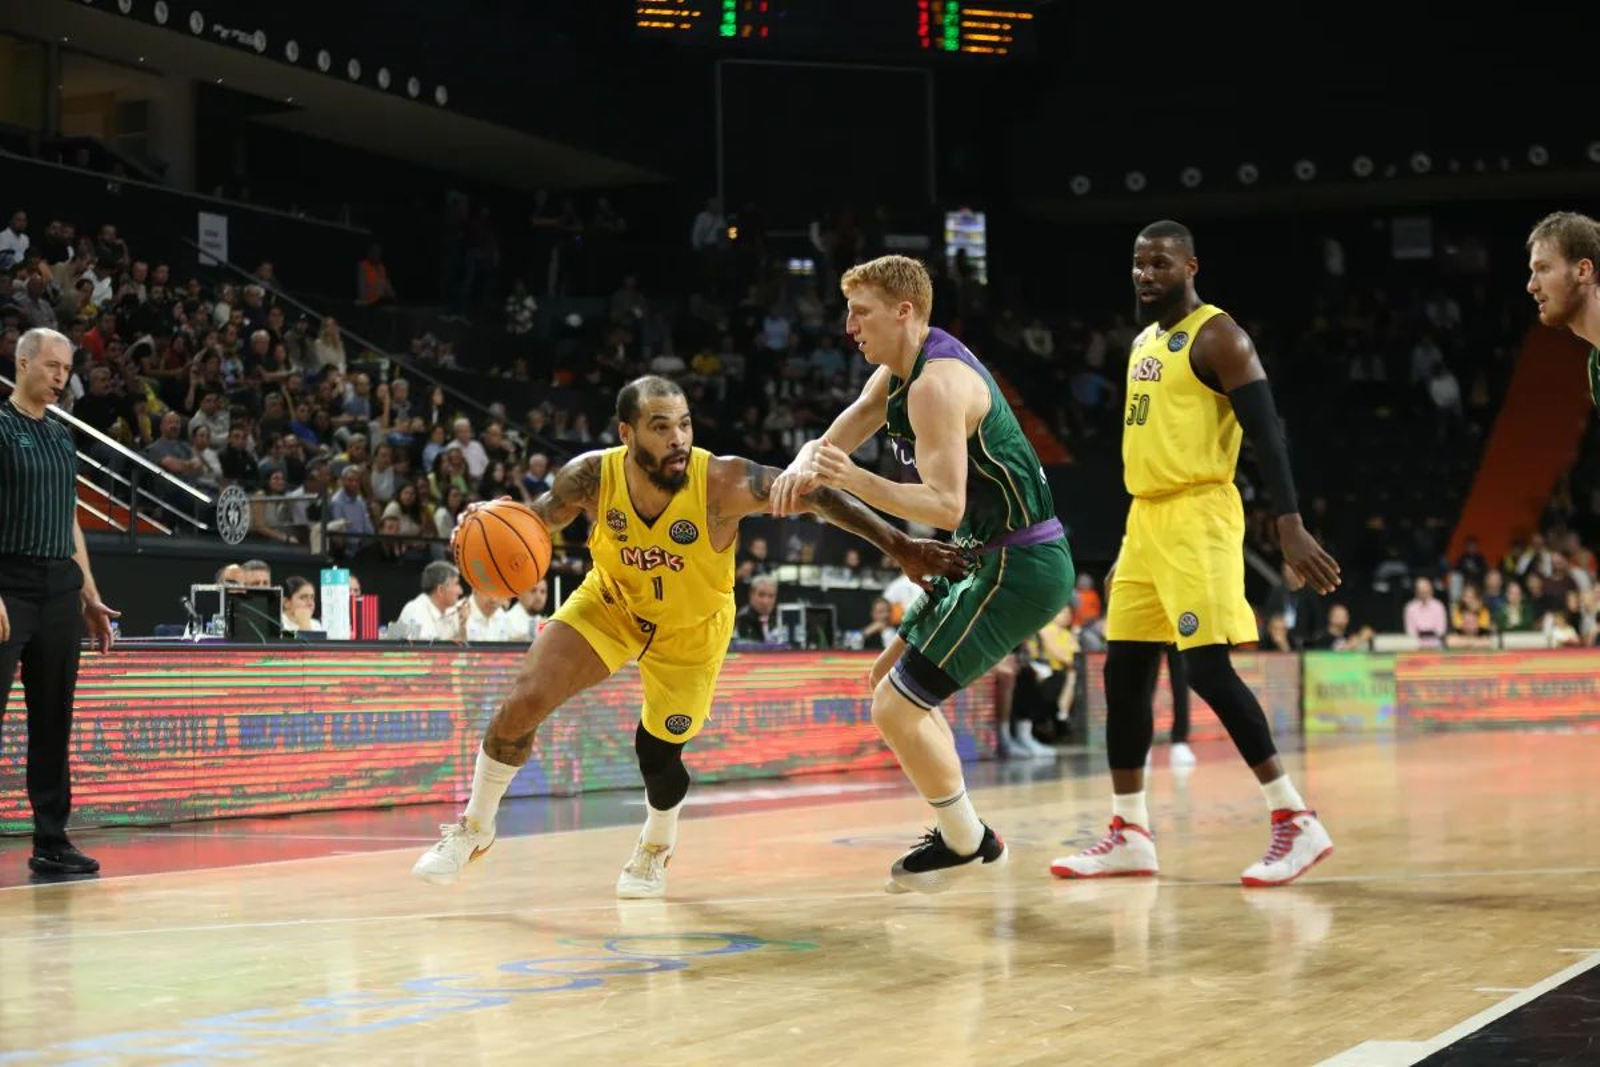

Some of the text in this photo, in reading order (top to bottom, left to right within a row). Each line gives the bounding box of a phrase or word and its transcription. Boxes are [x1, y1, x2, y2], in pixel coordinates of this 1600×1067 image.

[1126, 394, 1150, 425] 50
[621, 545, 684, 572] MSK
[652, 576, 663, 601] 1
